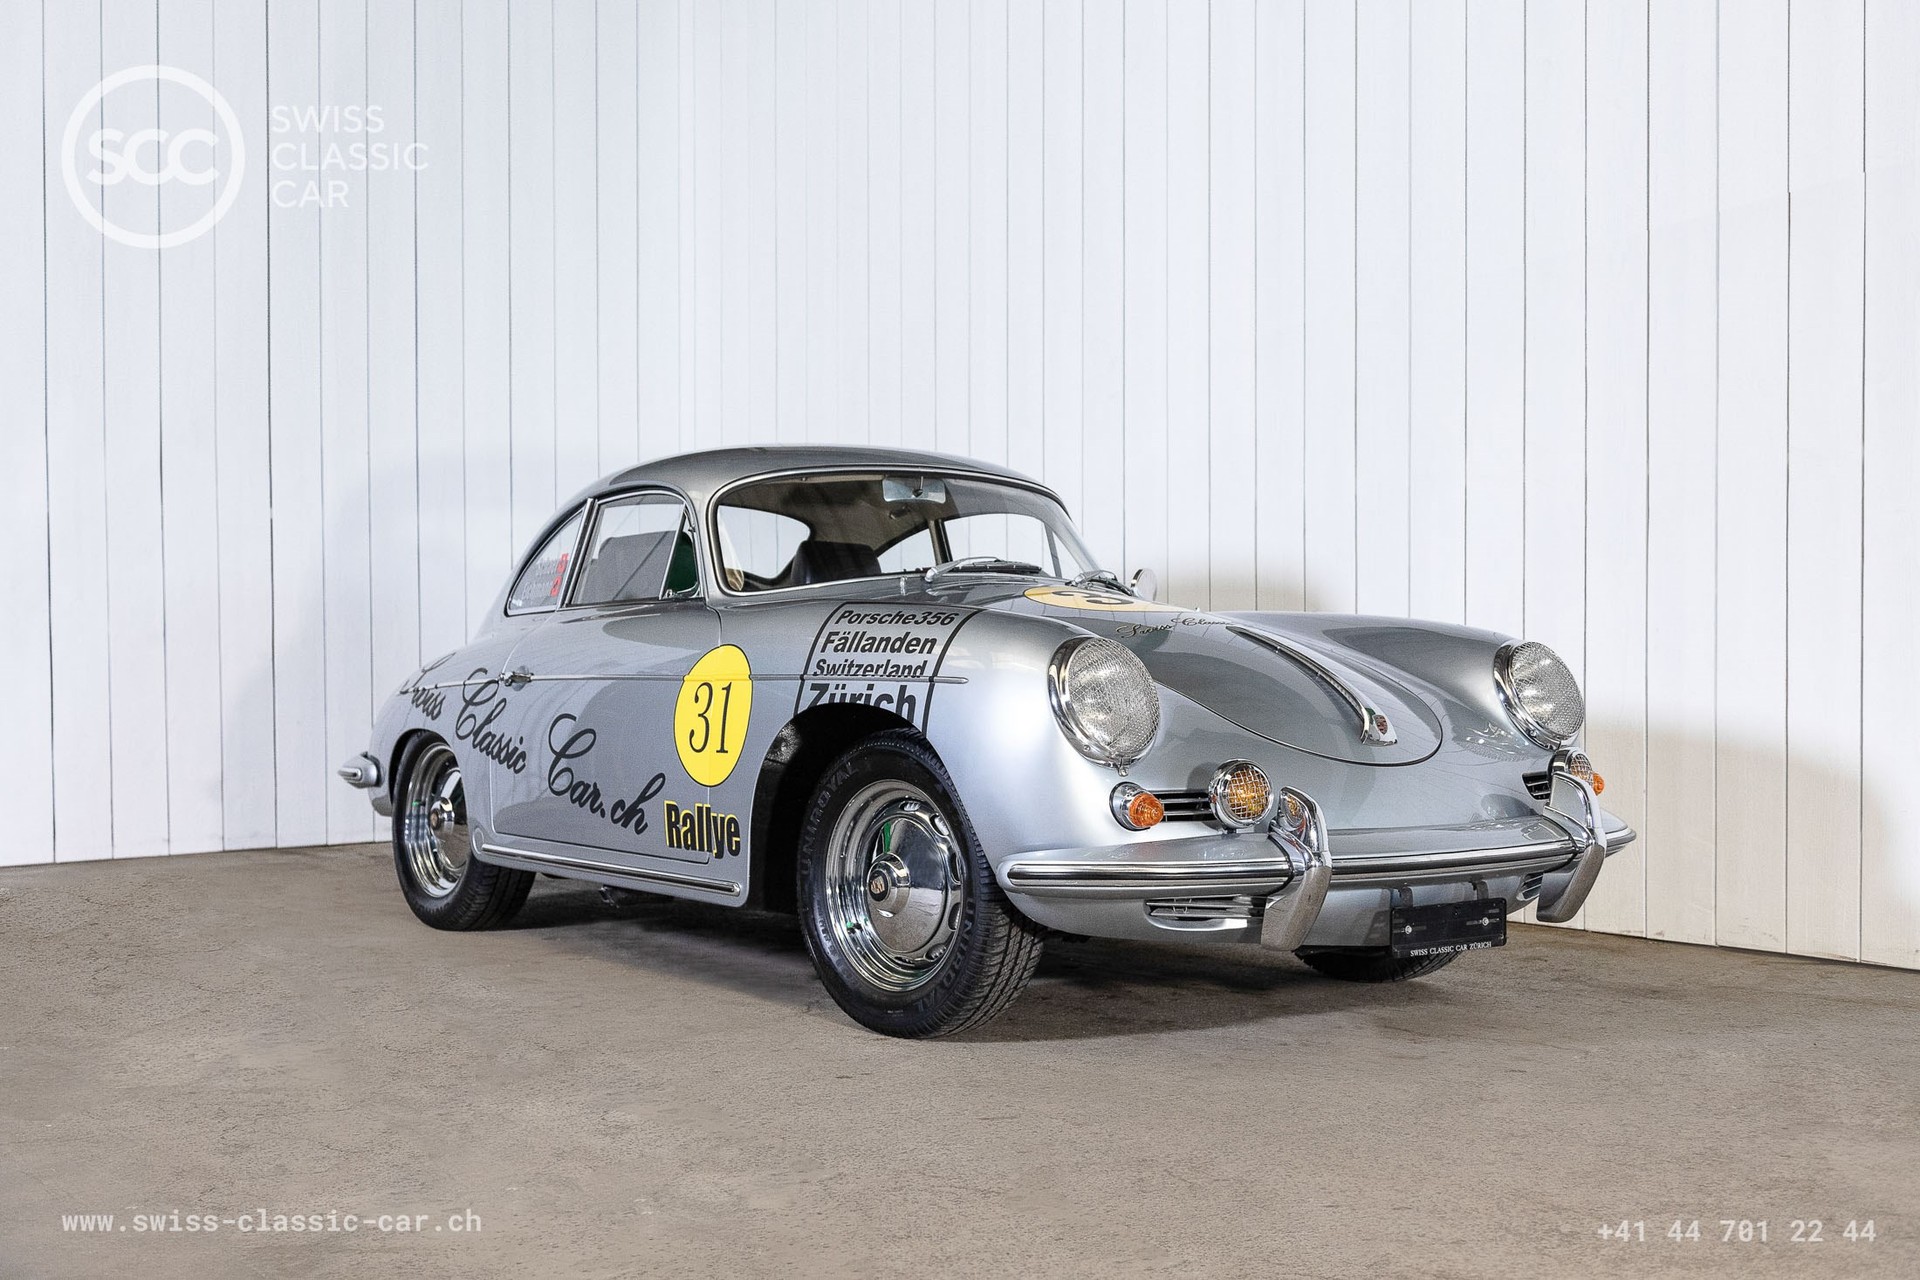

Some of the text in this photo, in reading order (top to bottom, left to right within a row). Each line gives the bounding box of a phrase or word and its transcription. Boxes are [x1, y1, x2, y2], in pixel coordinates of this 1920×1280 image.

[834, 610, 960, 626] Porsche356
[820, 631, 938, 655] Fällanden
[811, 658, 929, 679] Switzerland
[689, 681, 734, 754] 31
[456, 667, 527, 774] Classic
[548, 713, 666, 835] Car.ch
[664, 800, 742, 859] Rallye
[799, 760, 860, 876] UNIROYAL
[1410, 940, 1492, 957] SWISS CLASSIC CAR ZÜRICH
